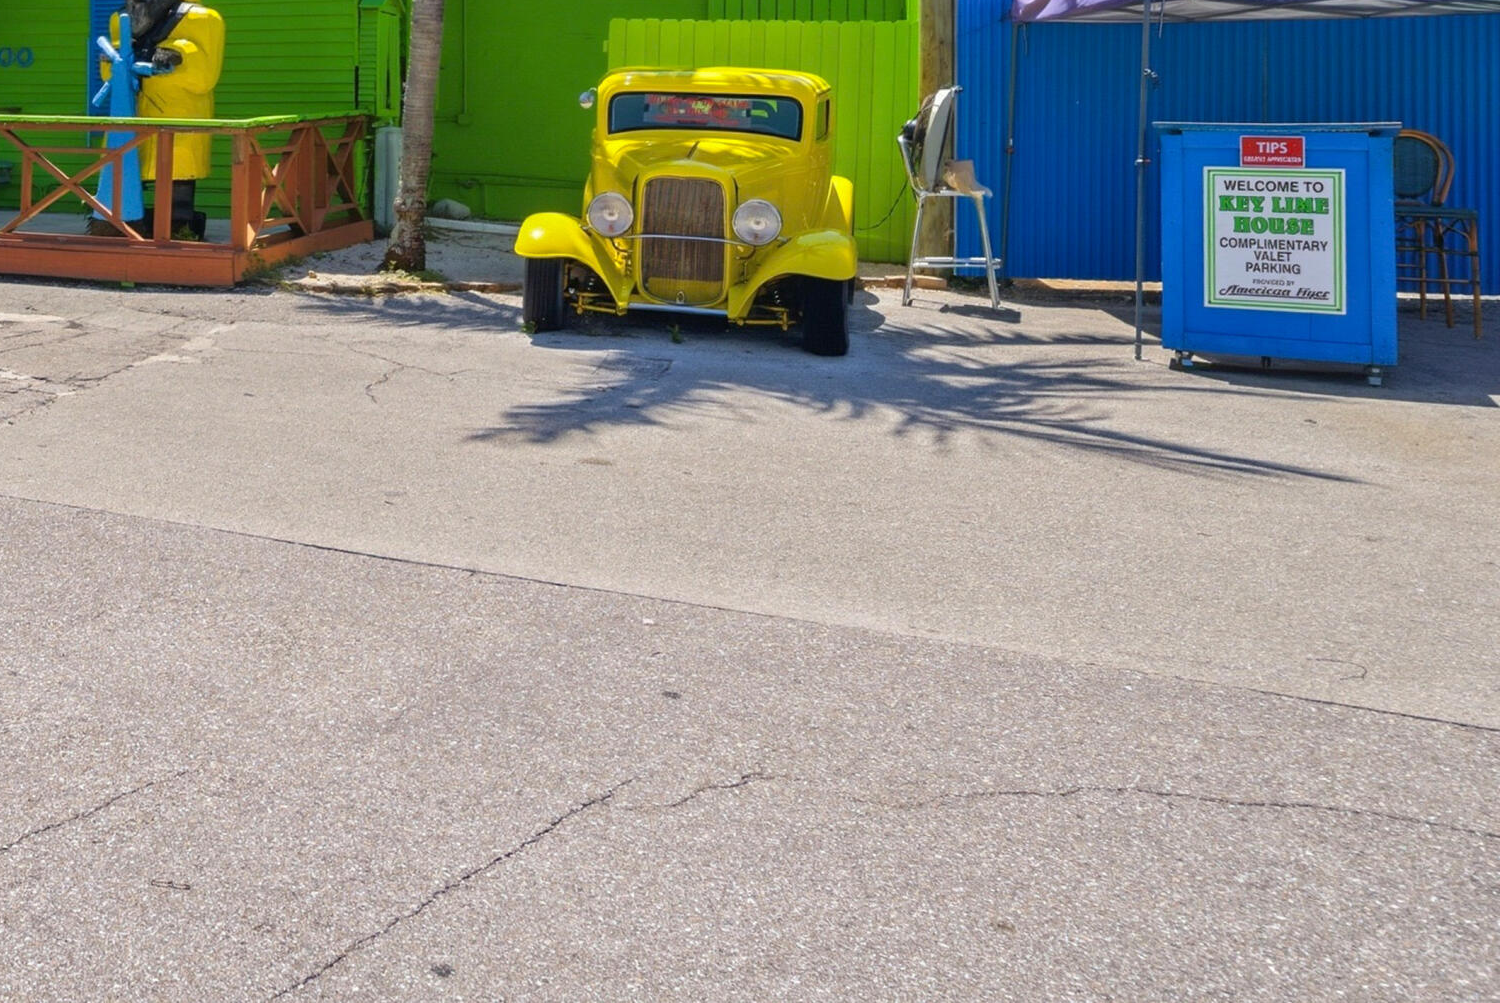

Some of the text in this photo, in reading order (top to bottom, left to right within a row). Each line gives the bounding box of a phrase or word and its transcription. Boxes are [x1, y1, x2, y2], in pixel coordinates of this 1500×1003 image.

[1255, 141, 1288, 154] TIPS
[1224, 179, 1324, 193] WELCOME TO
[1219, 195, 1329, 215] KEY LIME
[1233, 216, 1315, 236] HOUSE
[1220, 237, 1328, 252] COMPLIMENTARY
[1253, 250, 1292, 262] VALET
[1245, 261, 1301, 275] PARKING
[1219, 284, 1292, 297] American
